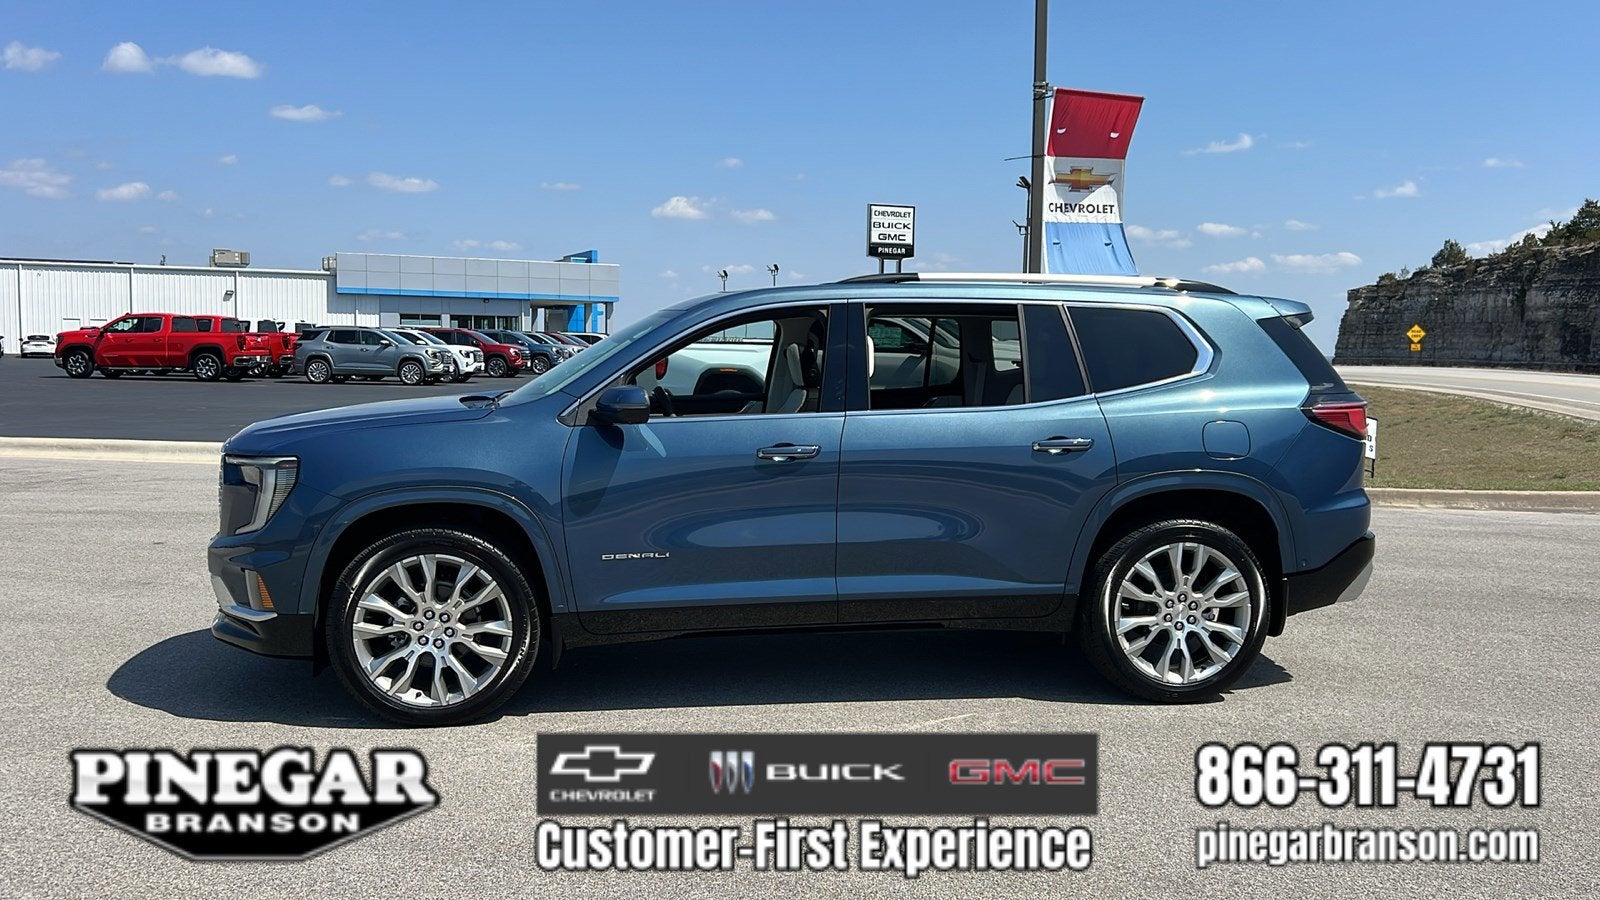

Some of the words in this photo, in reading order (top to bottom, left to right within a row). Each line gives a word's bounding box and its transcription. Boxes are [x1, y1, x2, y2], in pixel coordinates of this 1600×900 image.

[1048, 202, 1116, 214] CHEVROLET
[873, 209, 912, 218] CHEVROLET
[872, 221, 912, 230] BUICK
[877, 232, 907, 242] GMC
[877, 247, 906, 255] PINEGAR
[601, 551, 670, 560] DENALI
